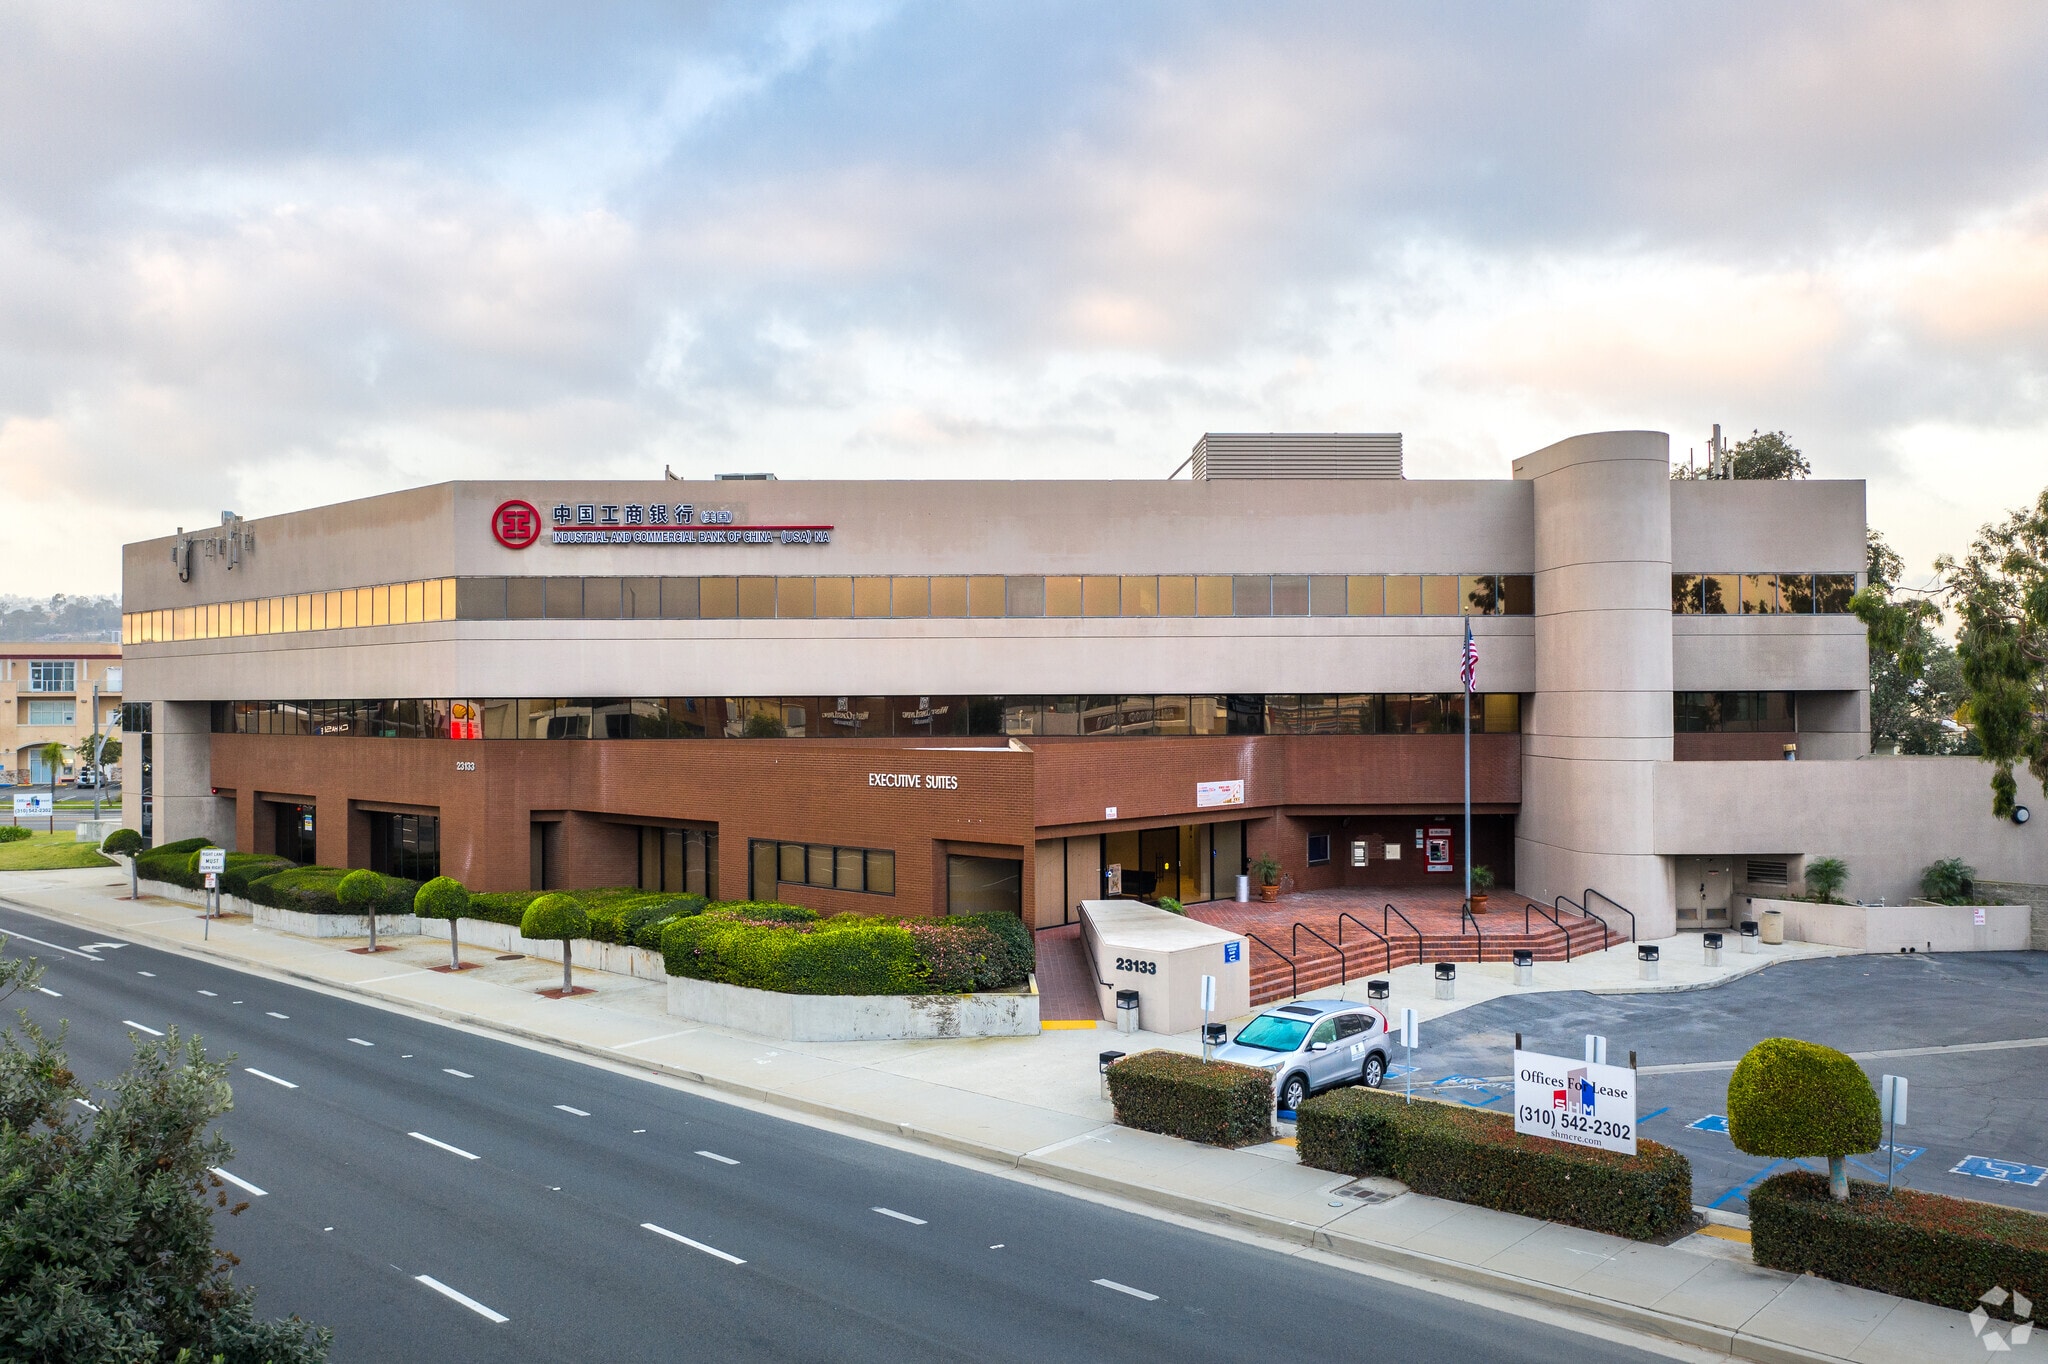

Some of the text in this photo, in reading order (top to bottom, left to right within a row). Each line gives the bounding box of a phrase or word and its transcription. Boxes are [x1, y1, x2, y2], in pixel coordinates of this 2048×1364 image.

[553, 503, 694, 525] 中国工商银行
[553, 530, 830, 544] INDUSTRIAL AND COMMERCIAL BANK OF CHINA (USA) NA
[456, 761, 475, 771] 23133
[868, 773, 958, 790] EXECUTIVE SUITES
[1116, 957, 1157, 975] 23133
[1520, 1069, 1564, 1088] Offices
[1568, 1077, 1587, 1092] For
[1592, 1081, 1628, 1099] Lease
[1554, 1098, 1595, 1117] SHM
[1519, 1105, 1631, 1140] (310) 542-2302
[1551, 1129, 1602, 1146] shmcre.com
